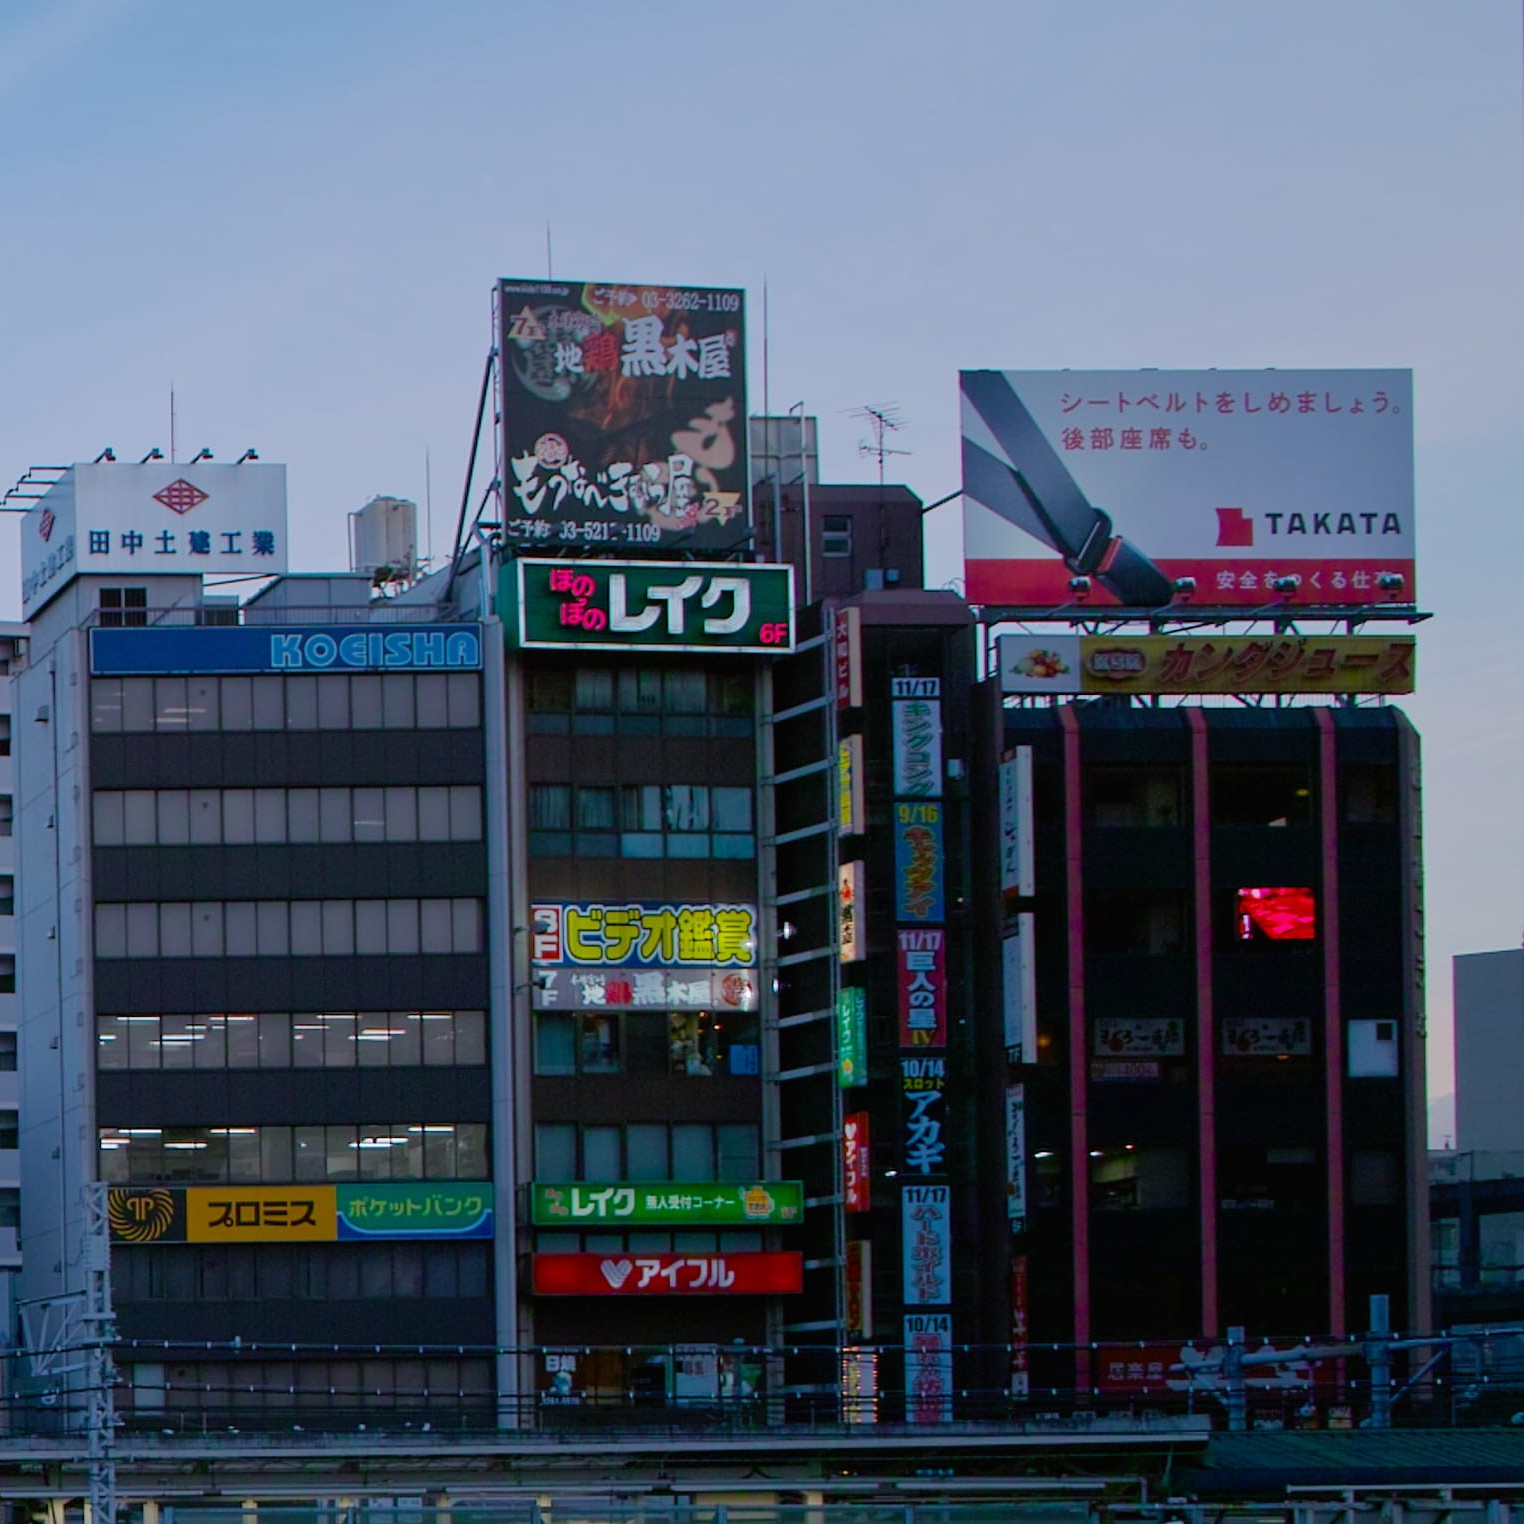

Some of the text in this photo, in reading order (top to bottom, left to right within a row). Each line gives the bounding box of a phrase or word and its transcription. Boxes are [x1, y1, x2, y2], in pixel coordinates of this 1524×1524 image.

[642, 292, 739, 312] 03-3262-1109
[1060, 390, 1401, 414] シートベルトをしめましょう。
[1061, 427, 1208, 450] 後部座席も。
[1265, 513, 1401, 535] TAKATA
[89, 530, 276, 556] 田中土建工業
[609, 573, 750, 634] レイク
[759, 622, 789, 644] 6F
[270, 633, 480, 667] KOEISHA
[1159, 642, 1412, 682] カンダジュース
[896, 680, 936, 696] 11/17
[567, 909, 752, 962] ビデオ鑑賞
[898, 931, 941, 950] 11/17
[904, 951, 940, 1029] 巨人の星
[901, 1059, 945, 1078] 10/14
[904, 1091, 946, 1173] アカギ
[347, 1195, 483, 1217] ポケットバンク
[571, 1186, 636, 1217] レイク
[906, 1187, 946, 1204] 11/17
[208, 1201, 317, 1227] プロミス
[635, 1258, 735, 1289] アイフル
[906, 1315, 948, 1333] 10/14
